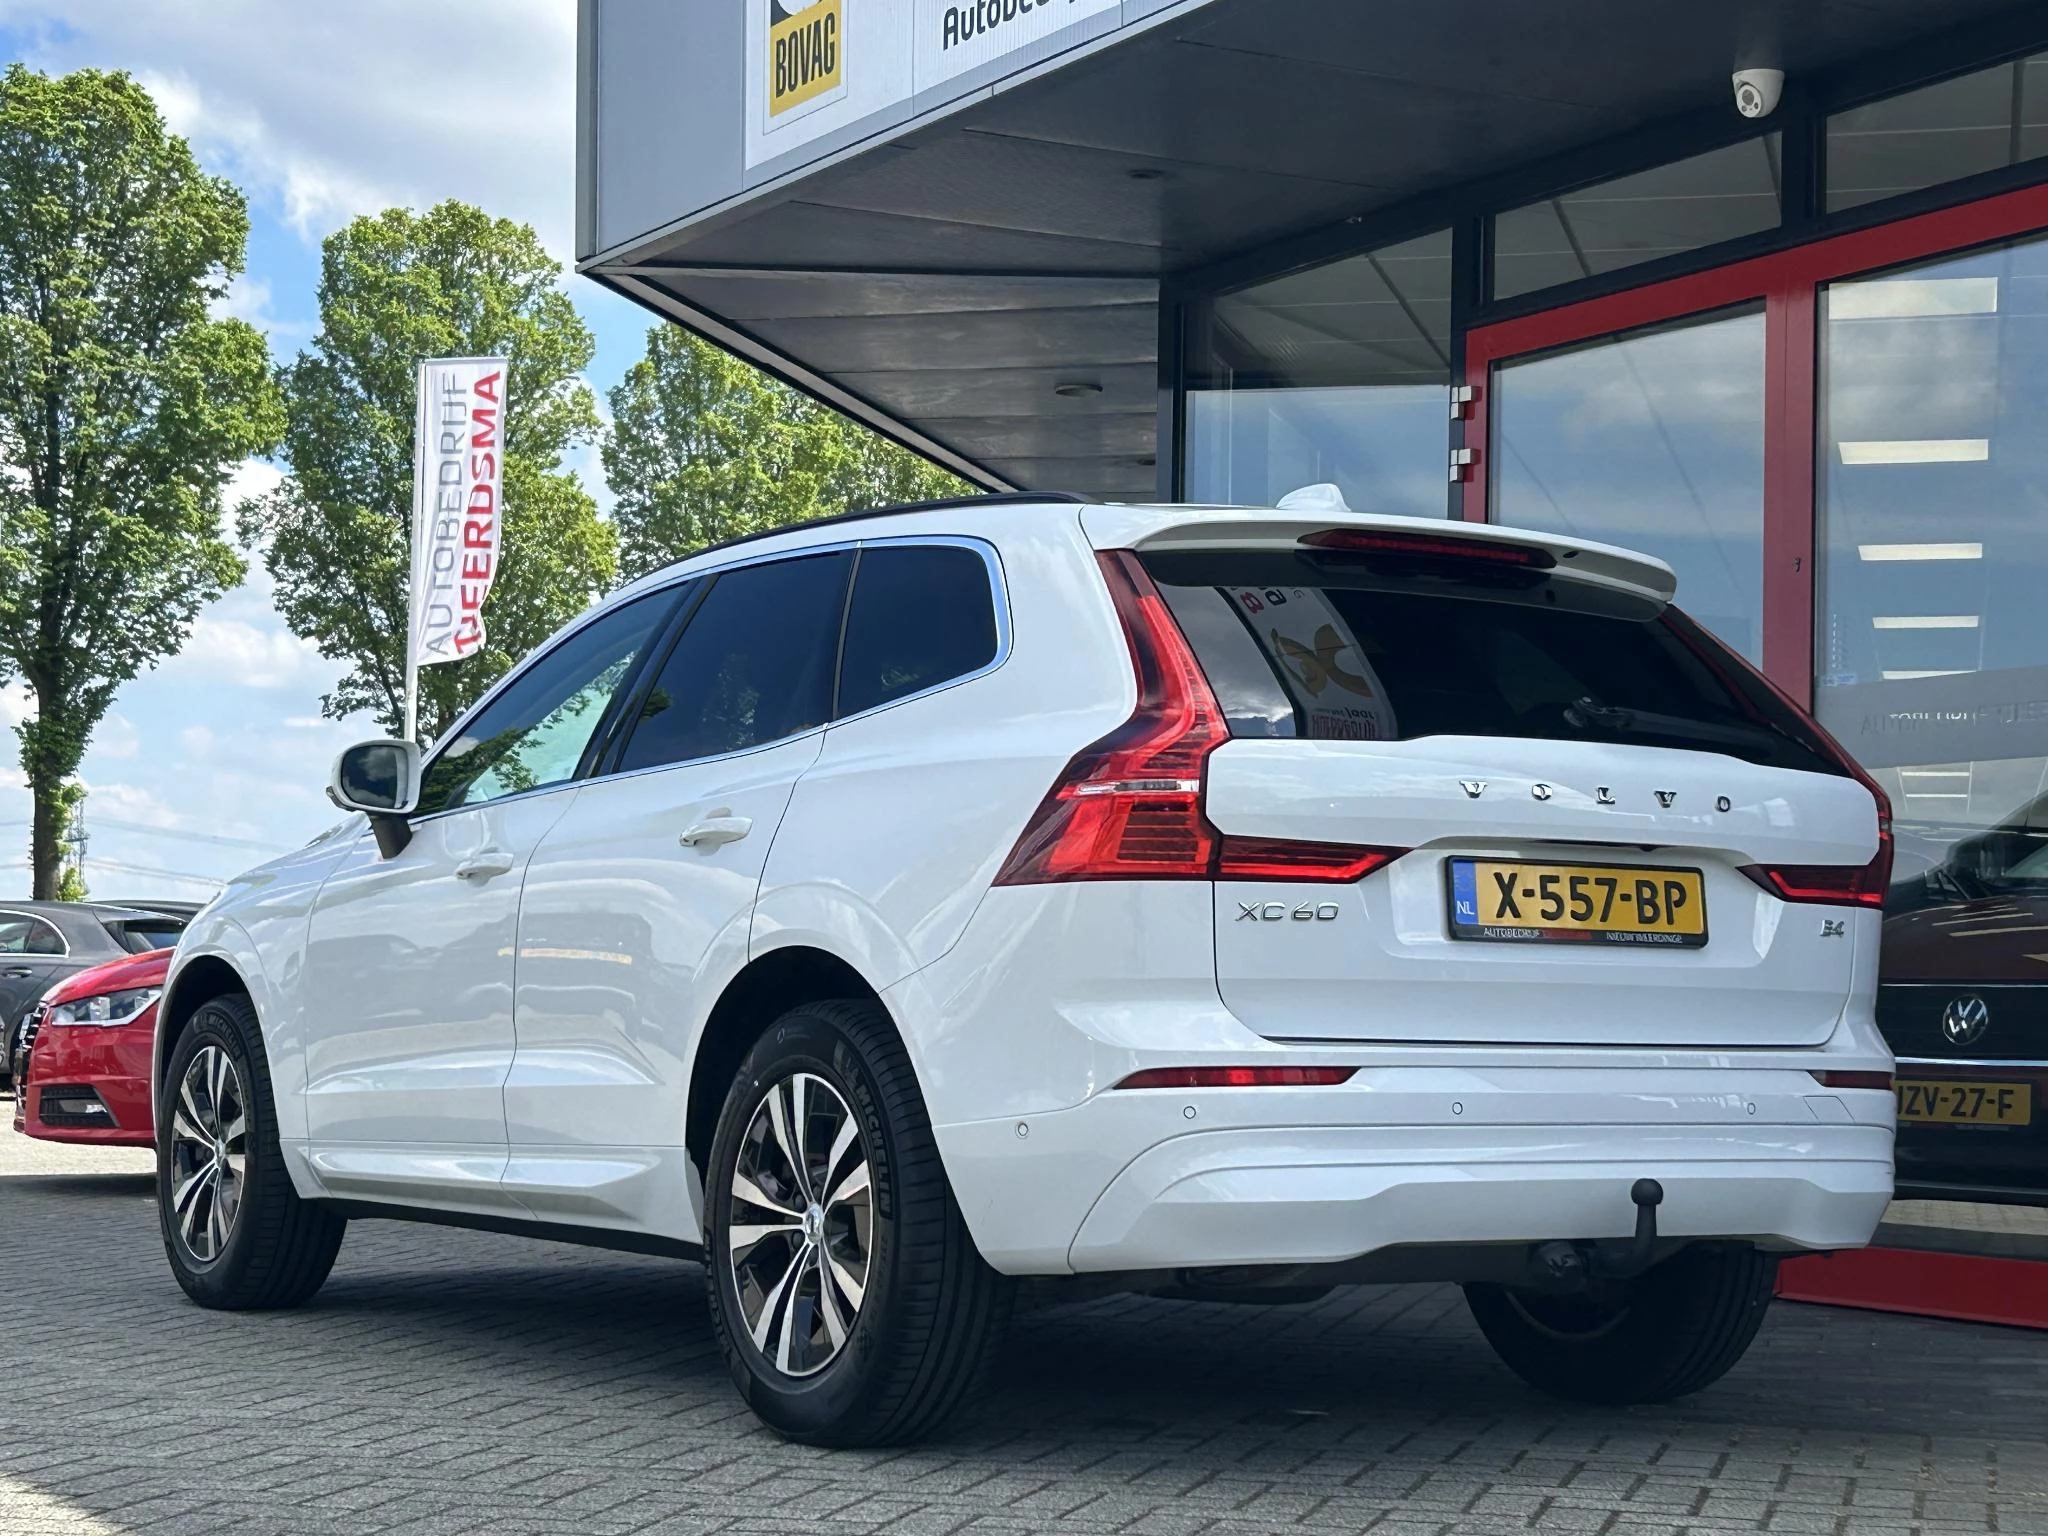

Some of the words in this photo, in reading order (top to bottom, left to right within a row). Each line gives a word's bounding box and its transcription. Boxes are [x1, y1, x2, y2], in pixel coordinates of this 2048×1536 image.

[775, 12, 836, 99] BOVAG
[426, 372, 467, 655] AUTOBEDRIJF
[1459, 780, 1732, 813] VOLVO
[1457, 901, 1475, 915] NL
[1493, 872, 1687, 925] X-557-BP
